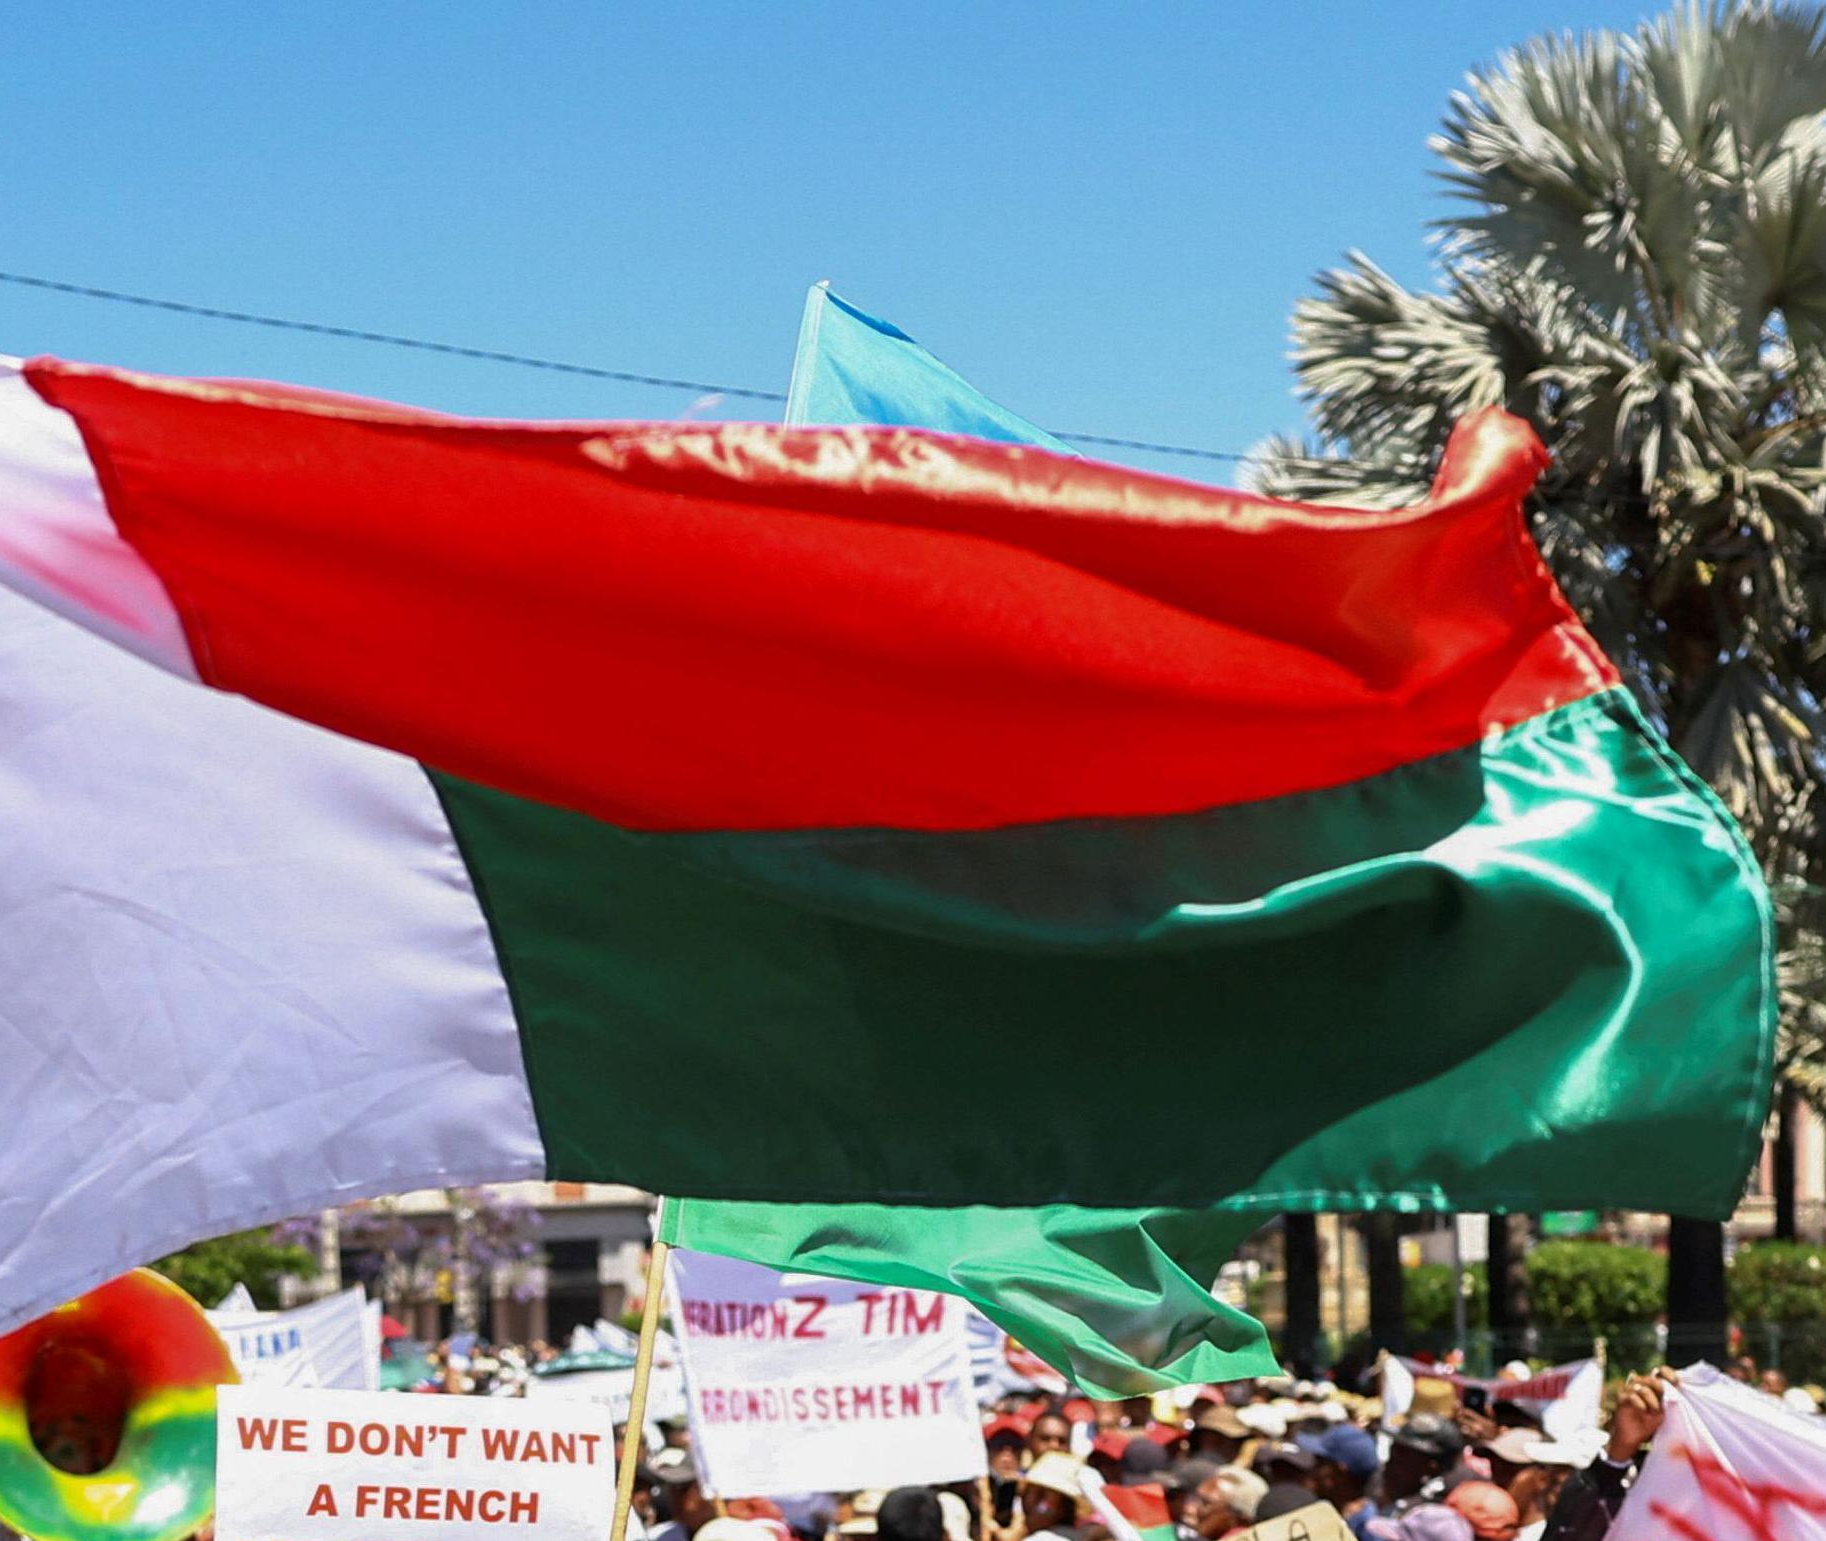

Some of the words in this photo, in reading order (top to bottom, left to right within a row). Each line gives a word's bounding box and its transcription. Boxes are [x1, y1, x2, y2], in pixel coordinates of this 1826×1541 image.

[856, 1290, 945, 1336] TIM
[237, 1417, 309, 1452] WE
[327, 1421, 467, 1459] DON'T
[481, 1428, 601, 1465] WANT
[306, 1484, 338, 1516] A
[355, 1485, 539, 1523] FRENCH
